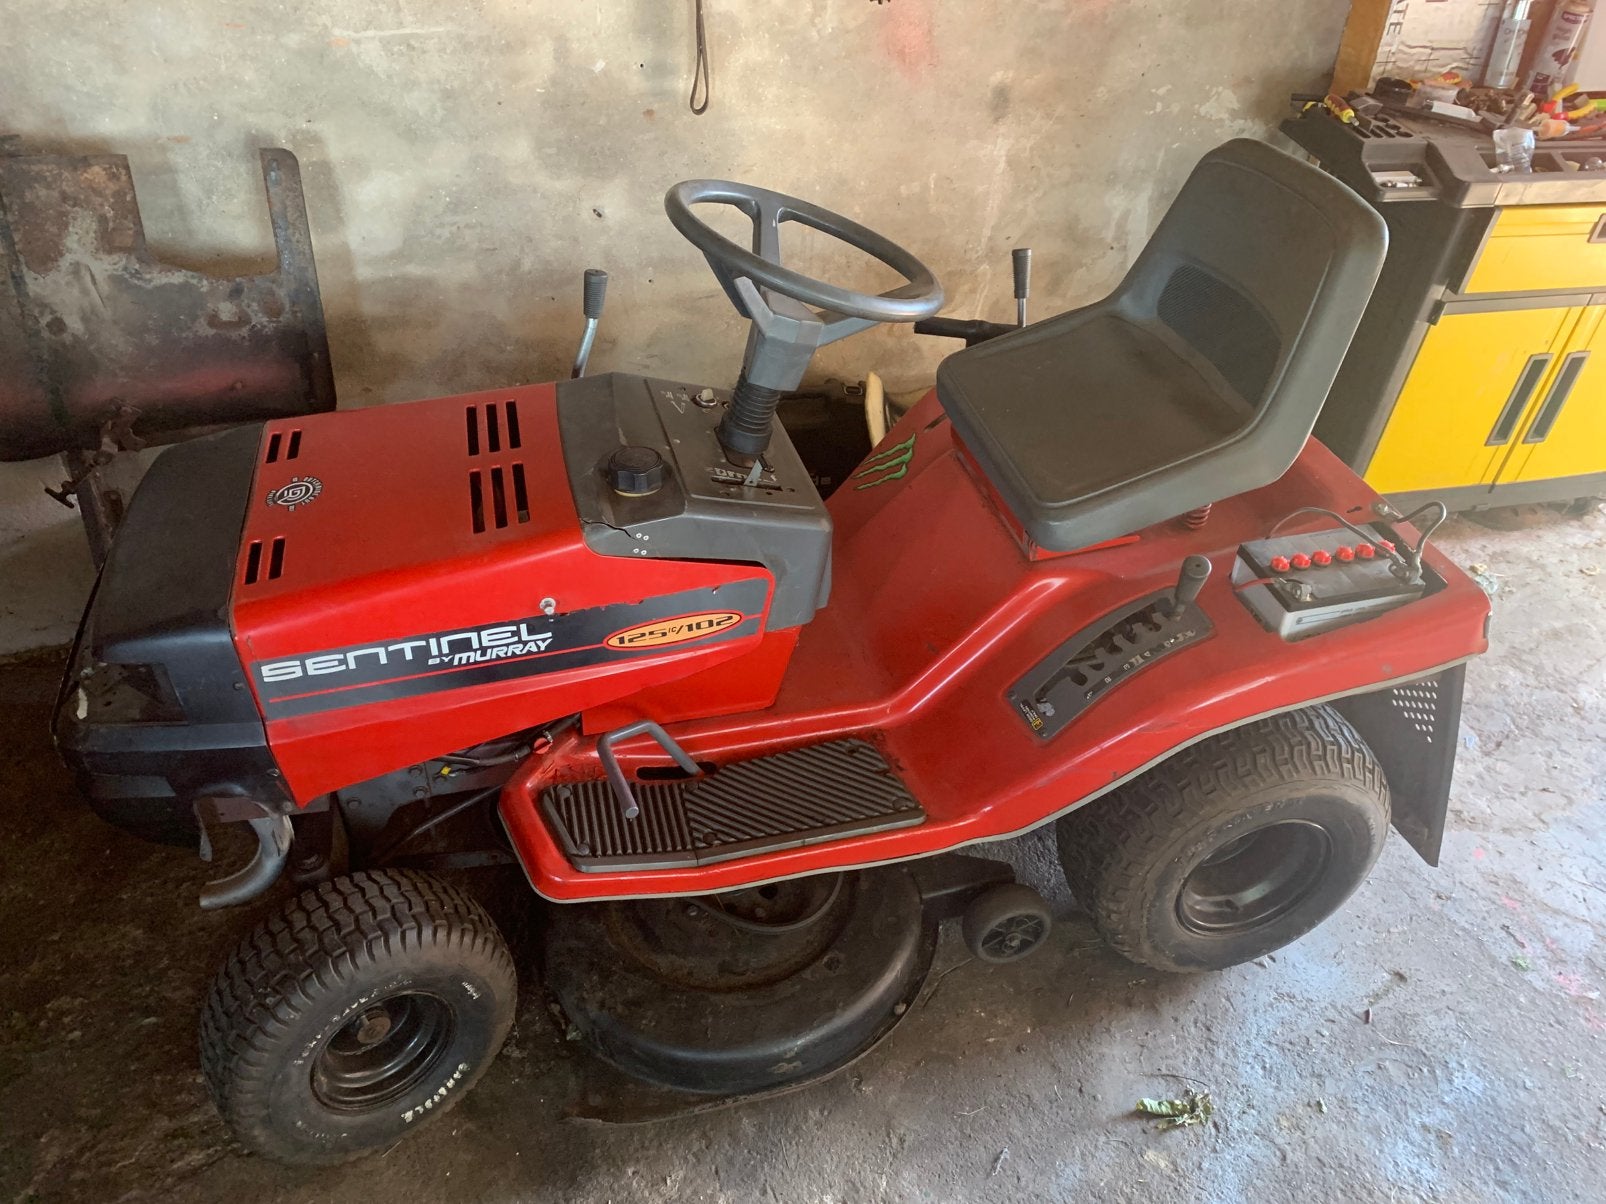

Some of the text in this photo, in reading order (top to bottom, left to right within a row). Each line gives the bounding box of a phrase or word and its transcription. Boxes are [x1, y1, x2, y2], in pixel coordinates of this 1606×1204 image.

[261, 623, 553, 682] SENTINEL
[428, 638, 553, 665] BY MURRAY
